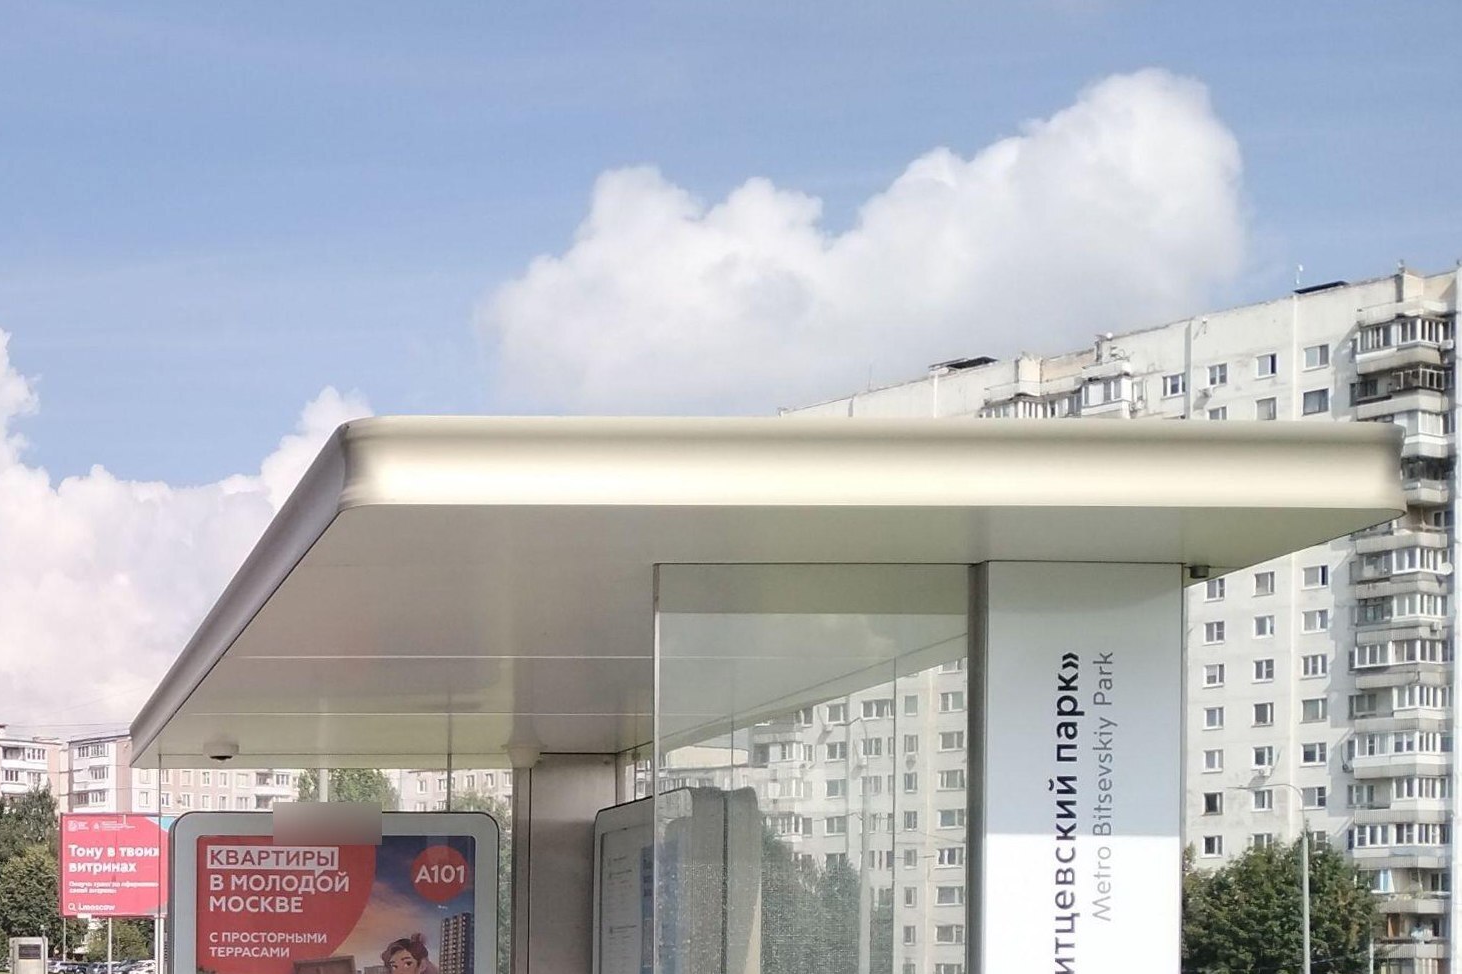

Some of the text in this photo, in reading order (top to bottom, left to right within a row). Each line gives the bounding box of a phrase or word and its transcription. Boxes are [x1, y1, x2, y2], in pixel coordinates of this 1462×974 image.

[1056, 652, 1085, 762] парк»
[1092, 651, 1118, 921] Metro Bitsevskiy Park
[68, 844, 160, 859] Тону в твоих
[209, 849, 335, 867] КВАРТИРЫ
[68, 863, 137, 875] витринах
[210, 871, 350, 894] В МОЛОДОЙ
[209, 896, 303, 912] МОСКВЕ
[209, 932, 327, 944] С ПРОСТОРНЫМИ
[209, 947, 289, 957] ТЕРРАСАМИ
